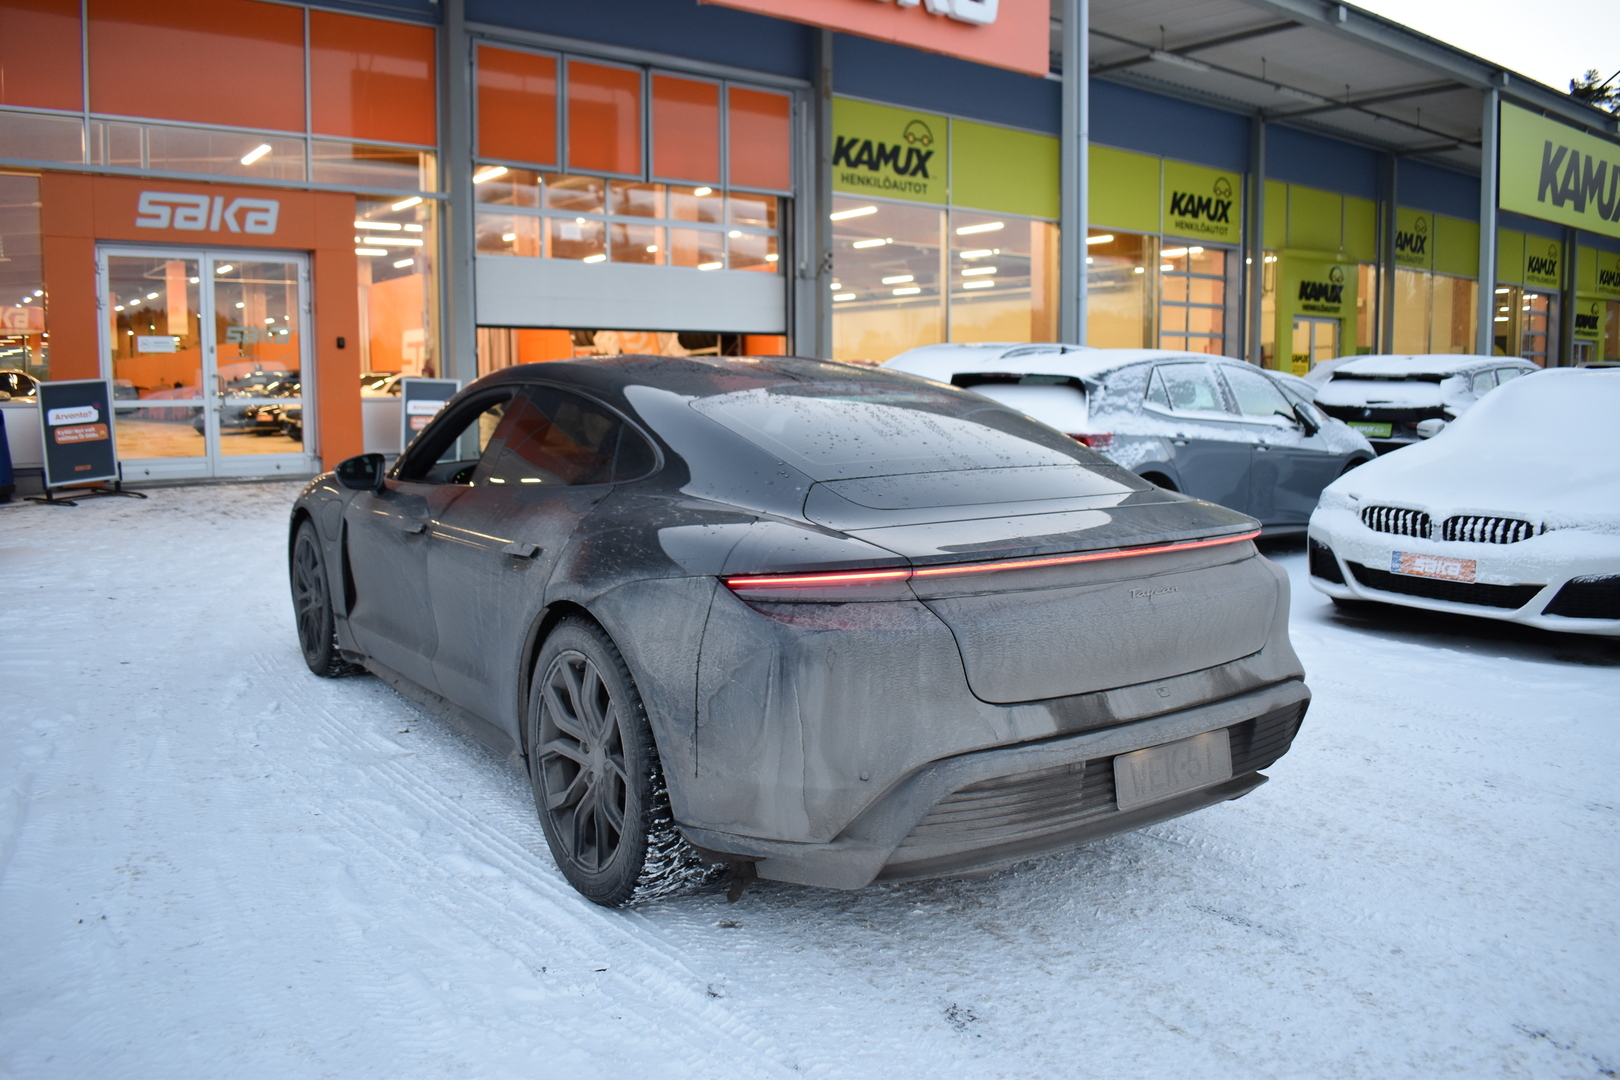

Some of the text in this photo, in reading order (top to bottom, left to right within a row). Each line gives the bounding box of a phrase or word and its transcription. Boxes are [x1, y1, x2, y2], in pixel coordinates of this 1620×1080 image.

[832, 135, 934, 179] KAMUX
[841, 172, 928, 194] HENKILÖAUTOT
[1170, 190, 1232, 224] KAMUX
[1175, 220, 1228, 236] HENKILÖAUTOT
[1395, 230, 1427, 255] AMUX
[1528, 256, 1557, 276] KAMUX
[1298, 280, 1344, 304] KAMUX
[1127, 586, 1178, 601] Taycan
